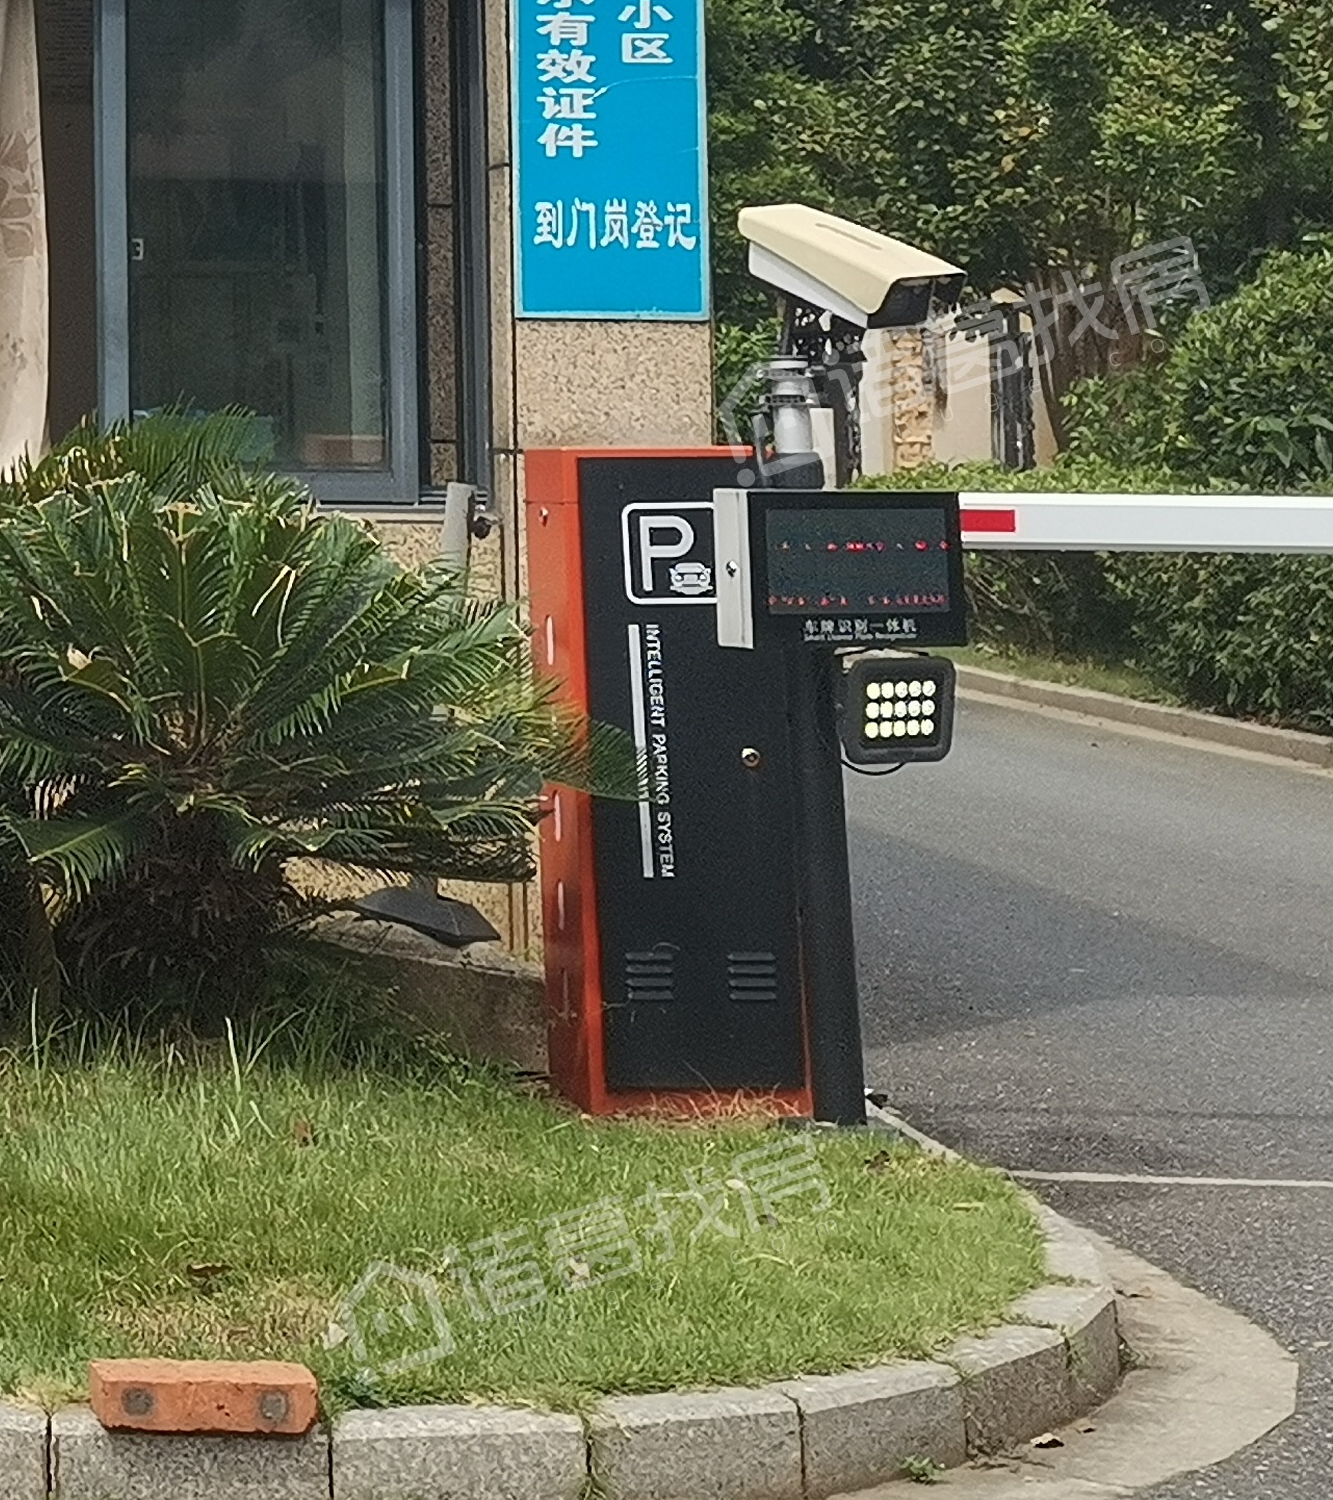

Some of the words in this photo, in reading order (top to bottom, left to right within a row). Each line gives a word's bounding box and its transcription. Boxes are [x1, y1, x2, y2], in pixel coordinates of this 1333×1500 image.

[533, 197, 697, 250] 到门岗登记
[645, 623, 666, 727] INTELLIGENT
[651, 734, 671, 804] PARKING
[656, 811, 675, 878] SYSTEM
